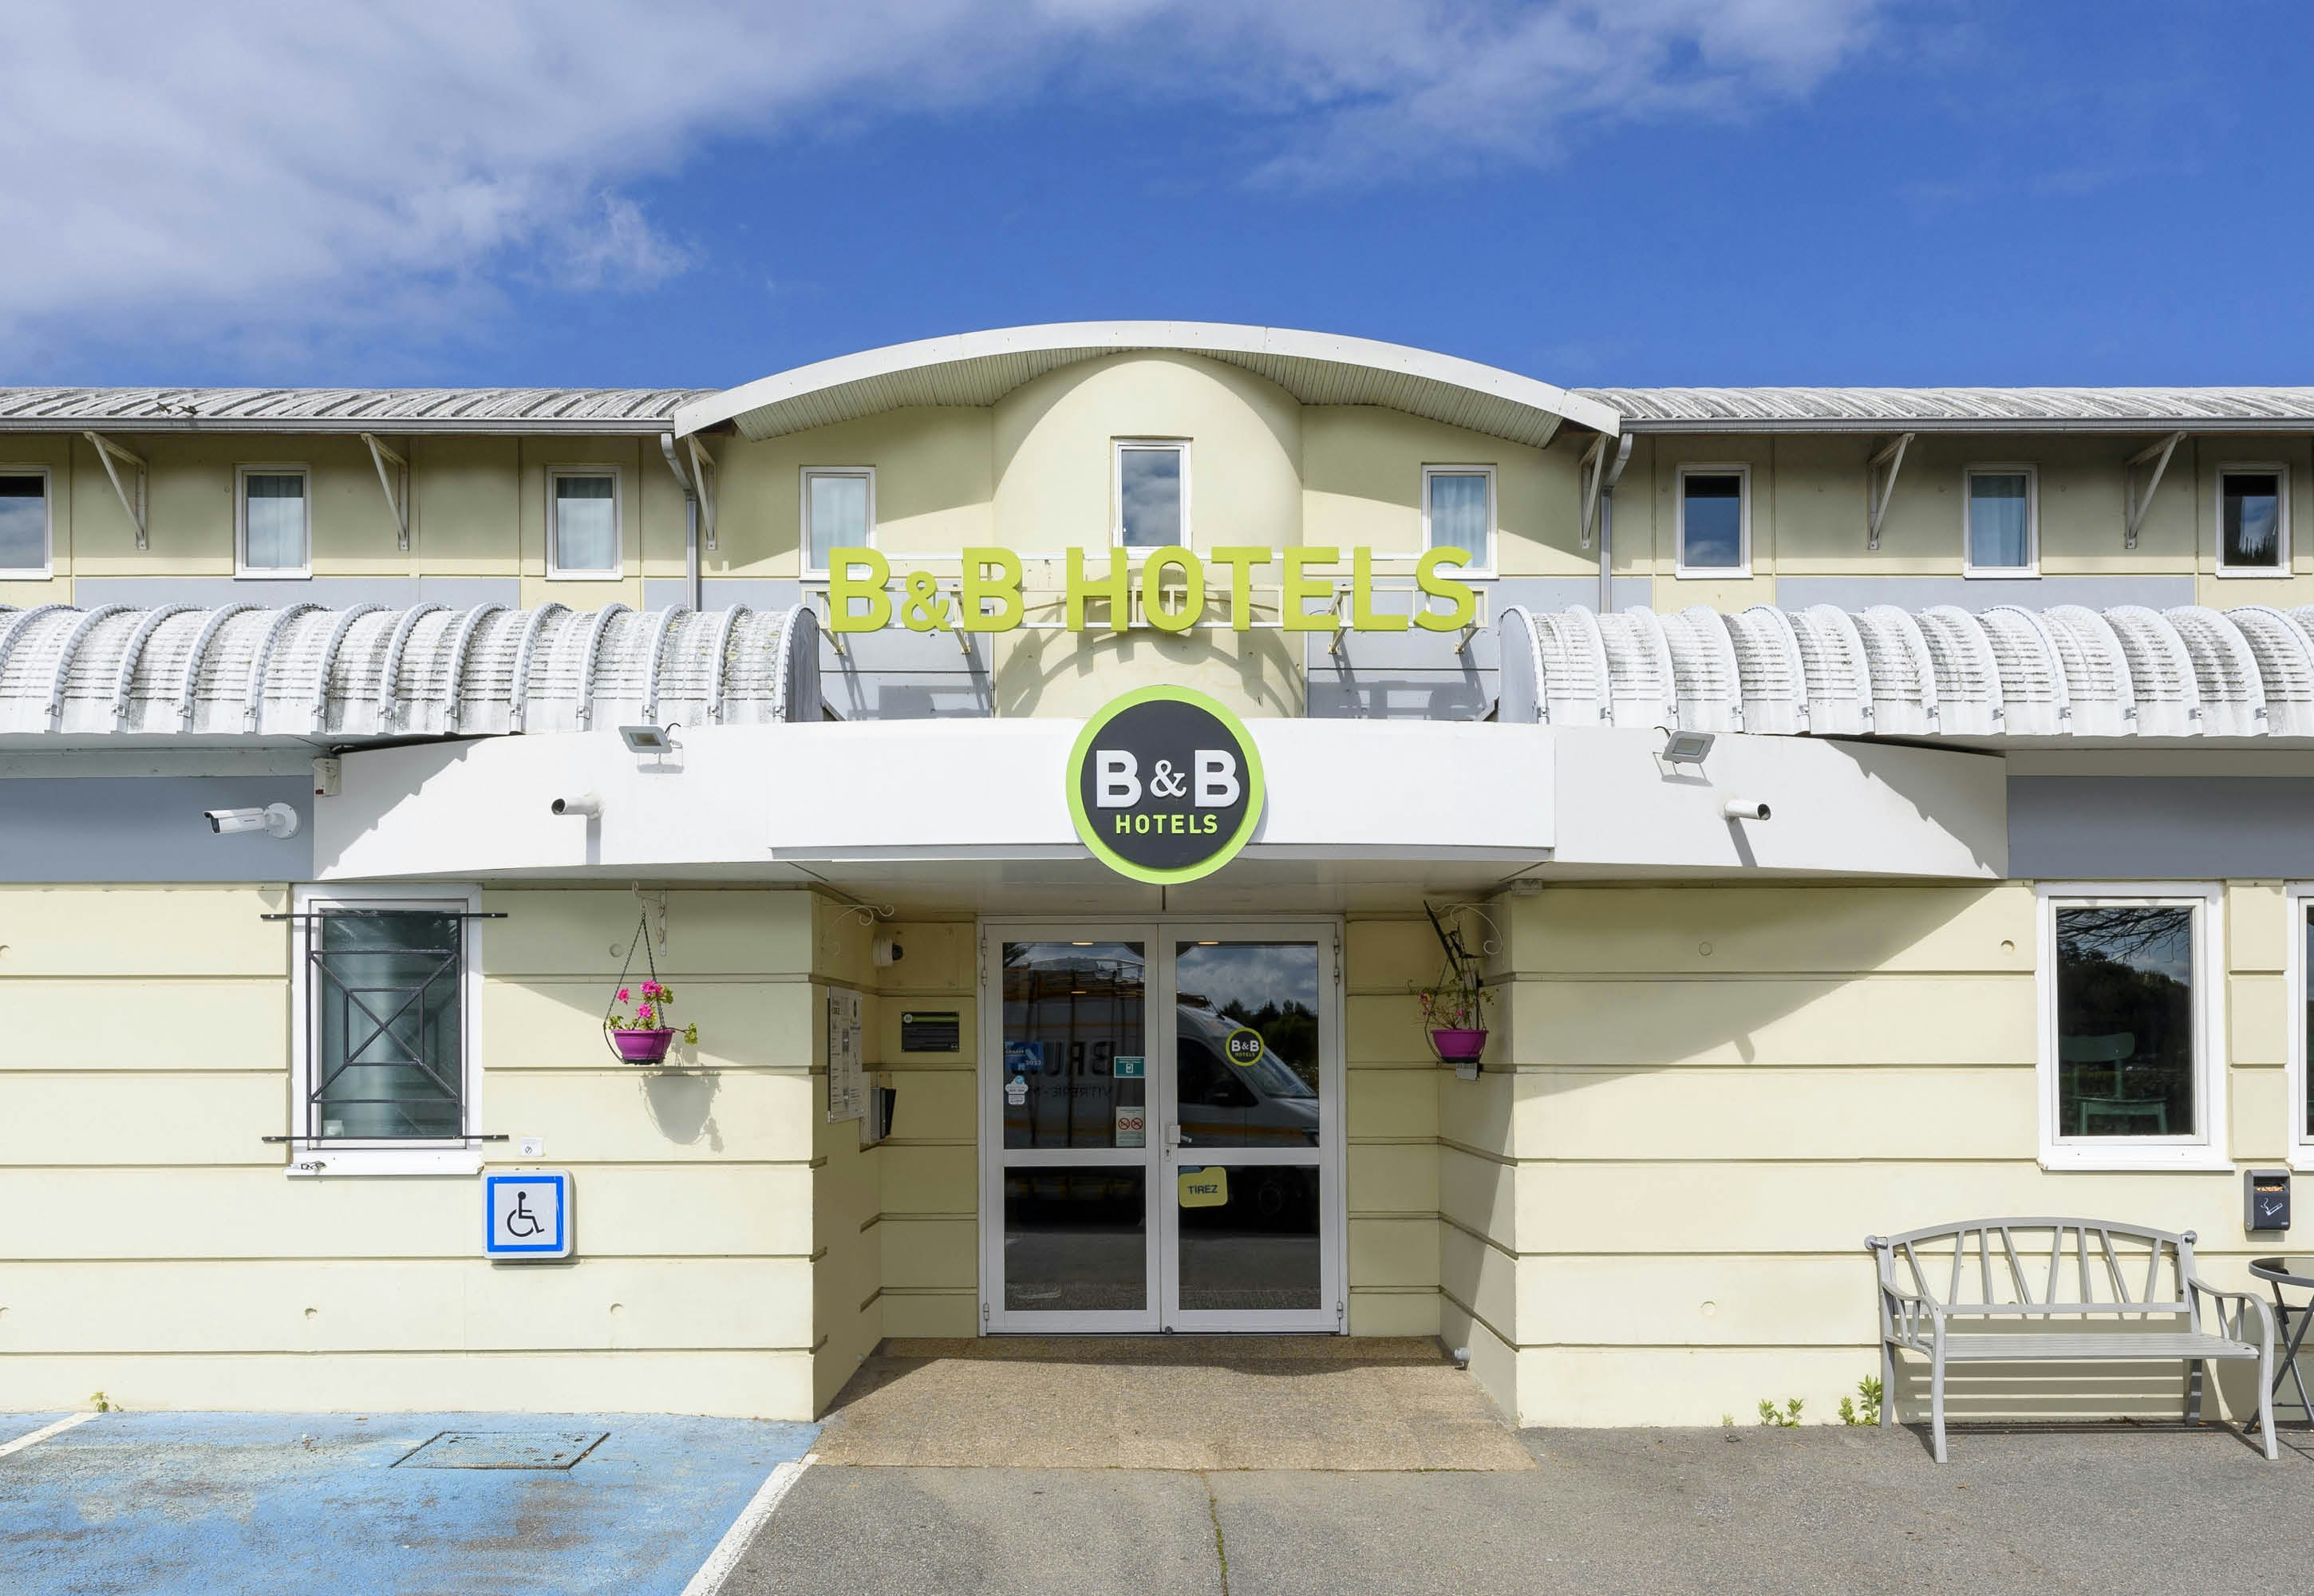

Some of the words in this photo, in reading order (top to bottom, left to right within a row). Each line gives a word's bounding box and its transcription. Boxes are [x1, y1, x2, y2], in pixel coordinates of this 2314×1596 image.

[828, 547, 1025, 633] B&B
[1067, 545, 1475, 633] HOTELS
[1096, 749, 1241, 808] B&B
[1116, 814, 1218, 835] HOTELS
[1231, 1040, 1260, 1052] B&B
[1187, 1184, 1218, 1195] TIREZ
